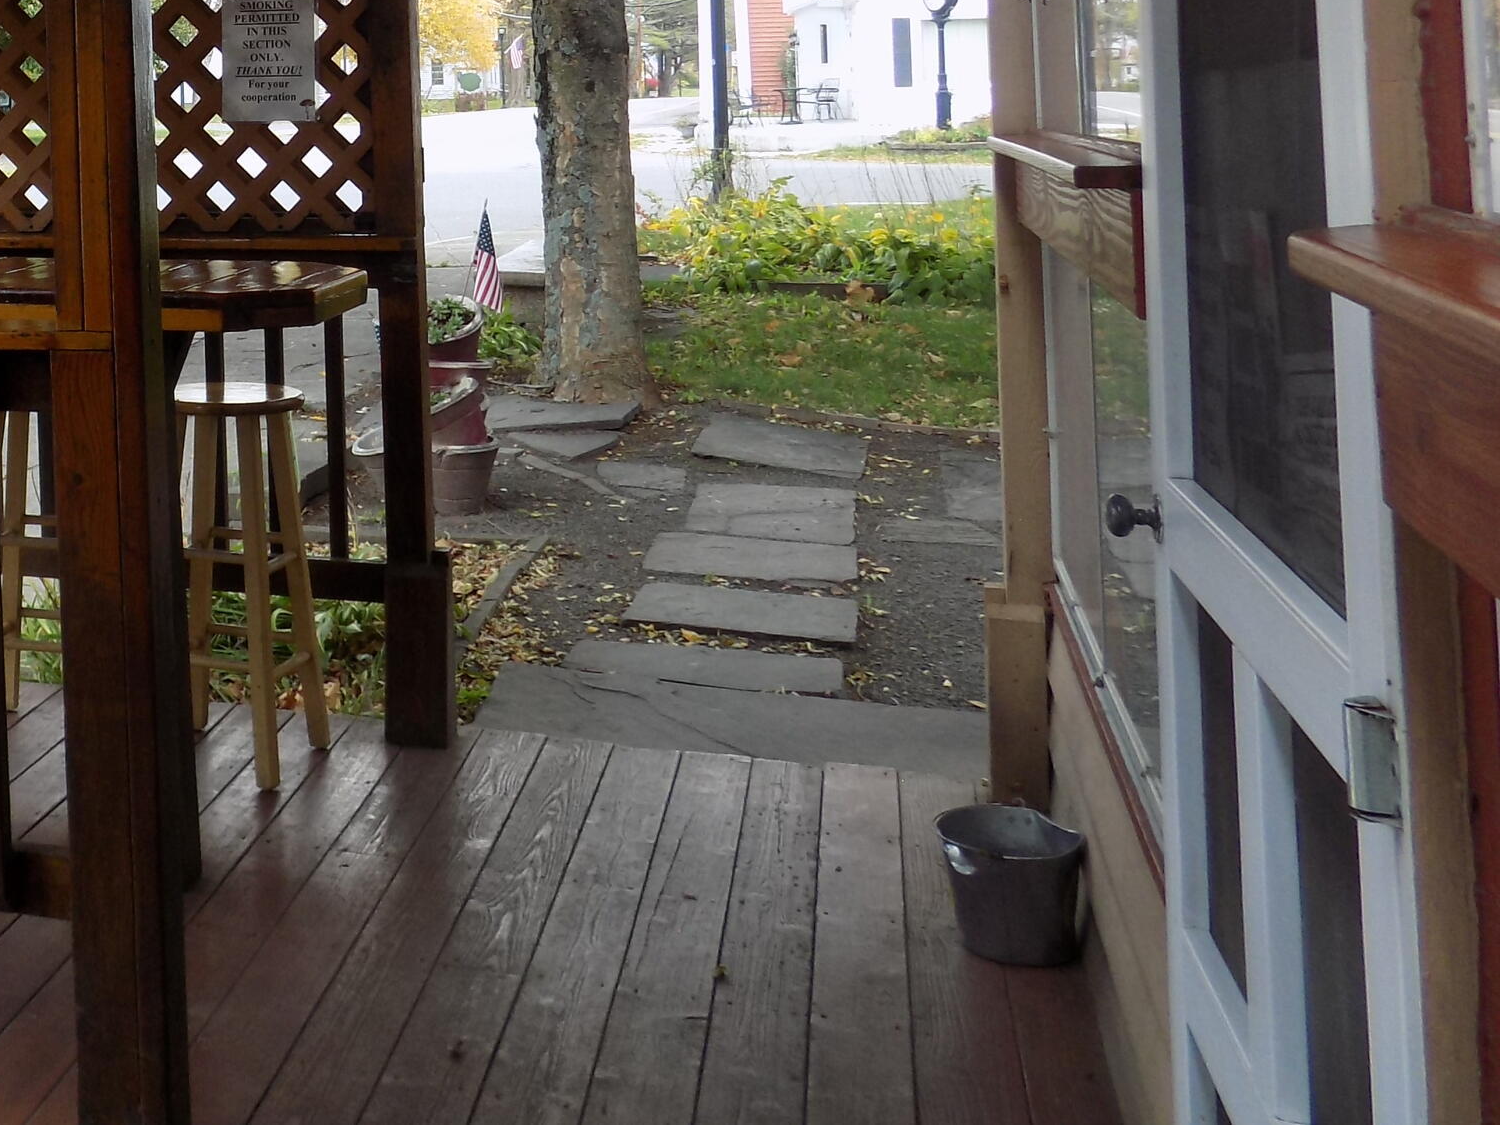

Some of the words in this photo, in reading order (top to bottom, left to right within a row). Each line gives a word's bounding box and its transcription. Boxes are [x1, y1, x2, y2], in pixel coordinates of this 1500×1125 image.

[240, 1, 293, 11] SMOKING
[234, 13, 300, 23] PERMITTED
[247, 27, 258, 36] IN
[261, 26, 287, 36] THIS
[243, 40, 291, 50] SECTION
[250, 53, 284, 63] ONLY.
[236, 66, 273, 75] THANK
[276, 66, 303, 75] YOU!
[249, 80, 266, 88] For
[267, 80, 290, 90] your
[241, 92, 297, 103] cooperation
